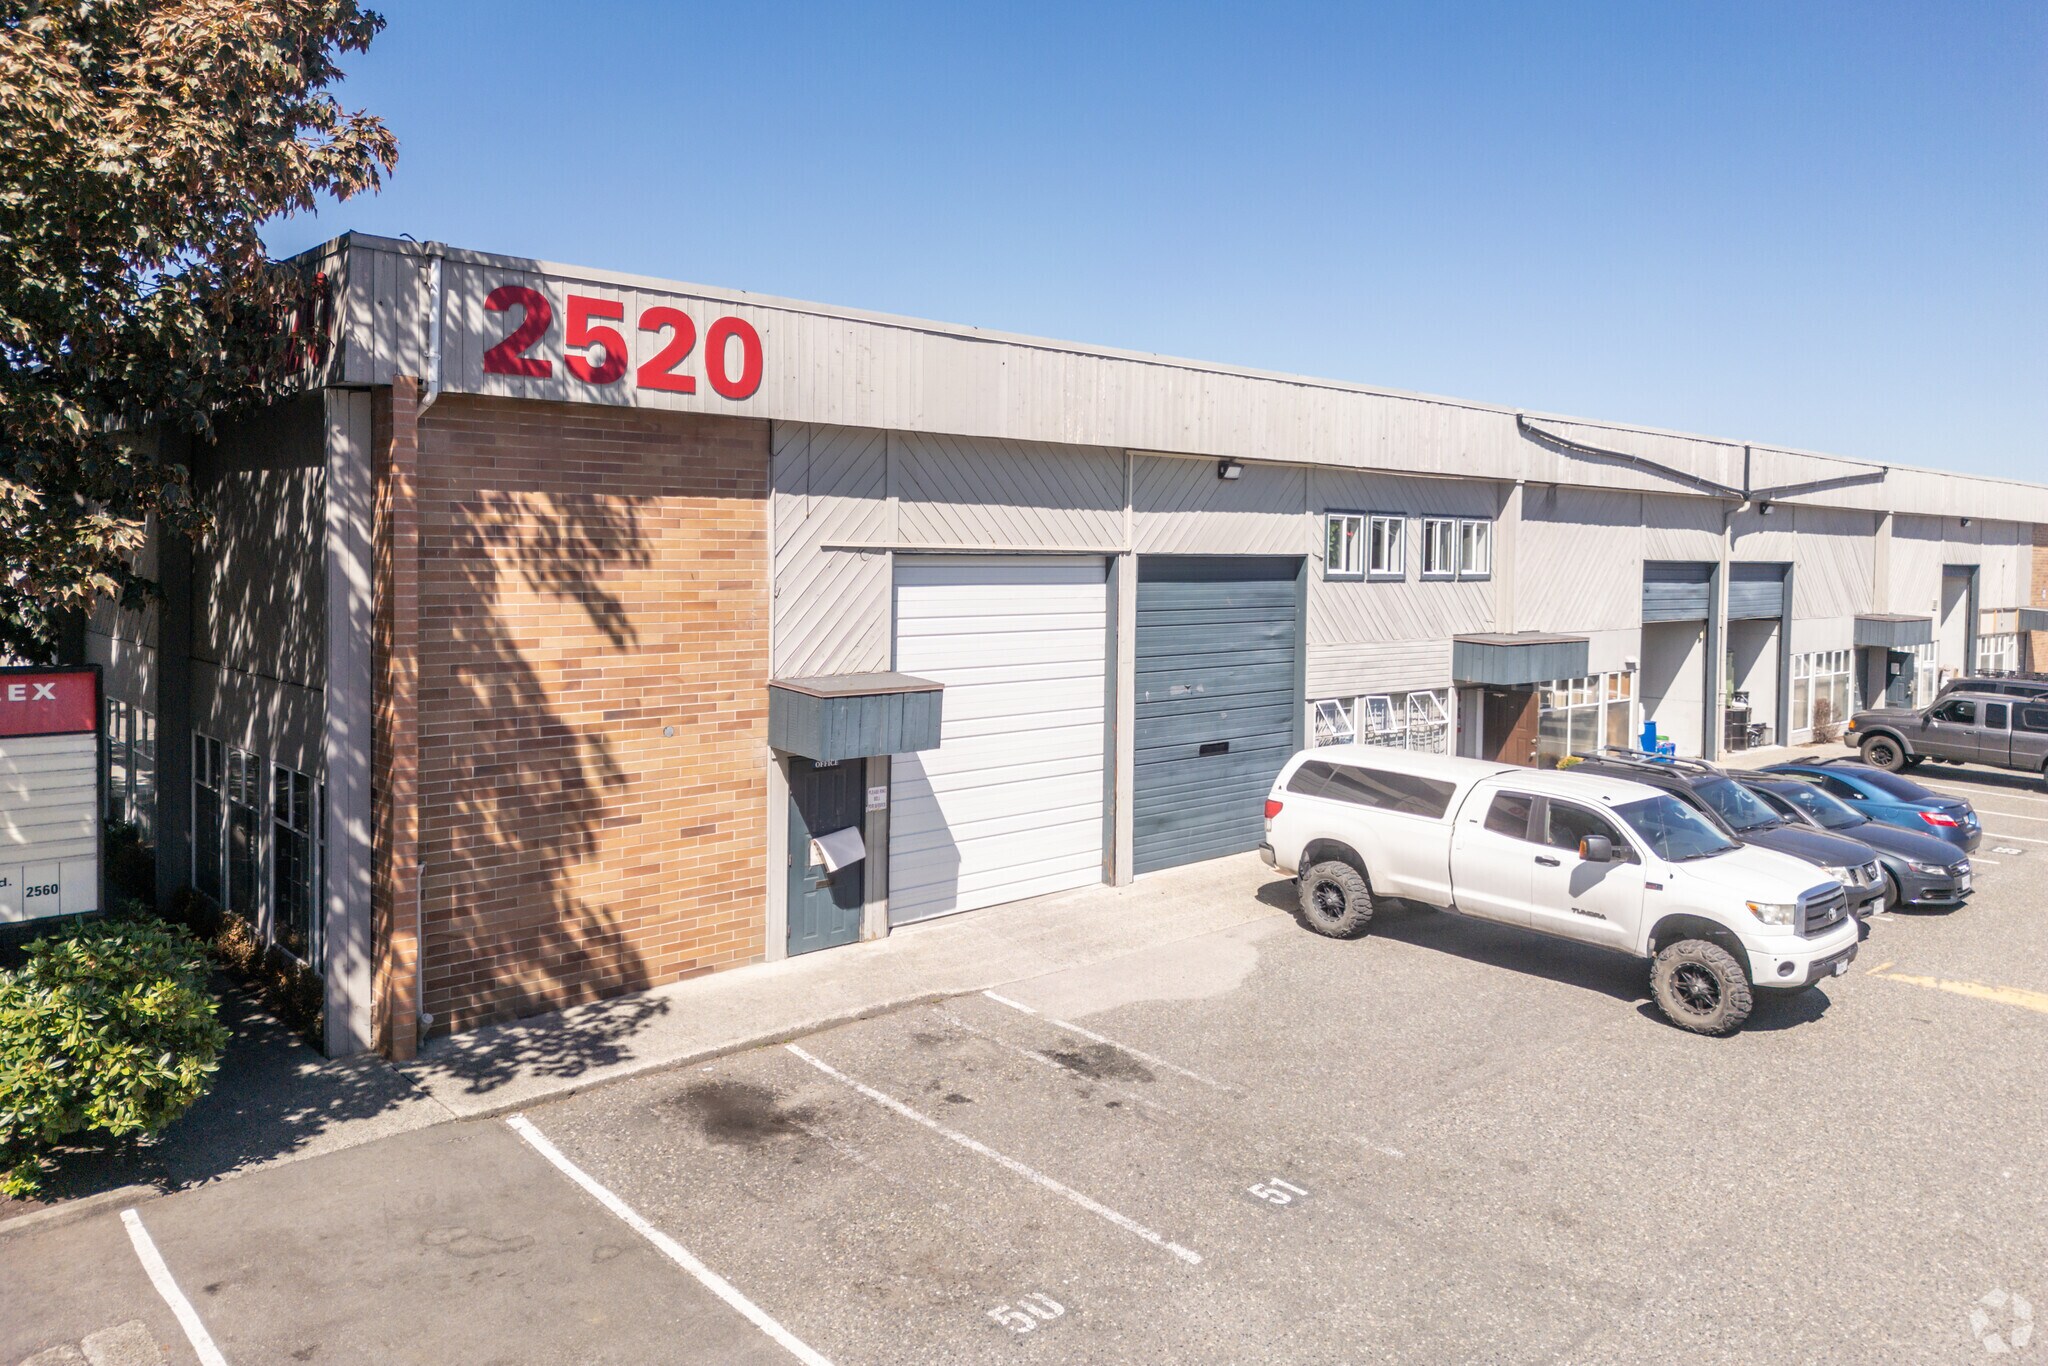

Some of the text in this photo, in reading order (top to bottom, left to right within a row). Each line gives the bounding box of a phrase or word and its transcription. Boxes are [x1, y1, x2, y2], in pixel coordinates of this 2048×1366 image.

[483, 285, 763, 400] 2520
[0, 682, 57, 702] EX
[26, 883, 59, 898] 2560
[1571, 907, 1607, 920] TUNDRA
[1247, 1177, 1308, 1205] 51
[986, 1292, 1065, 1333] 50
